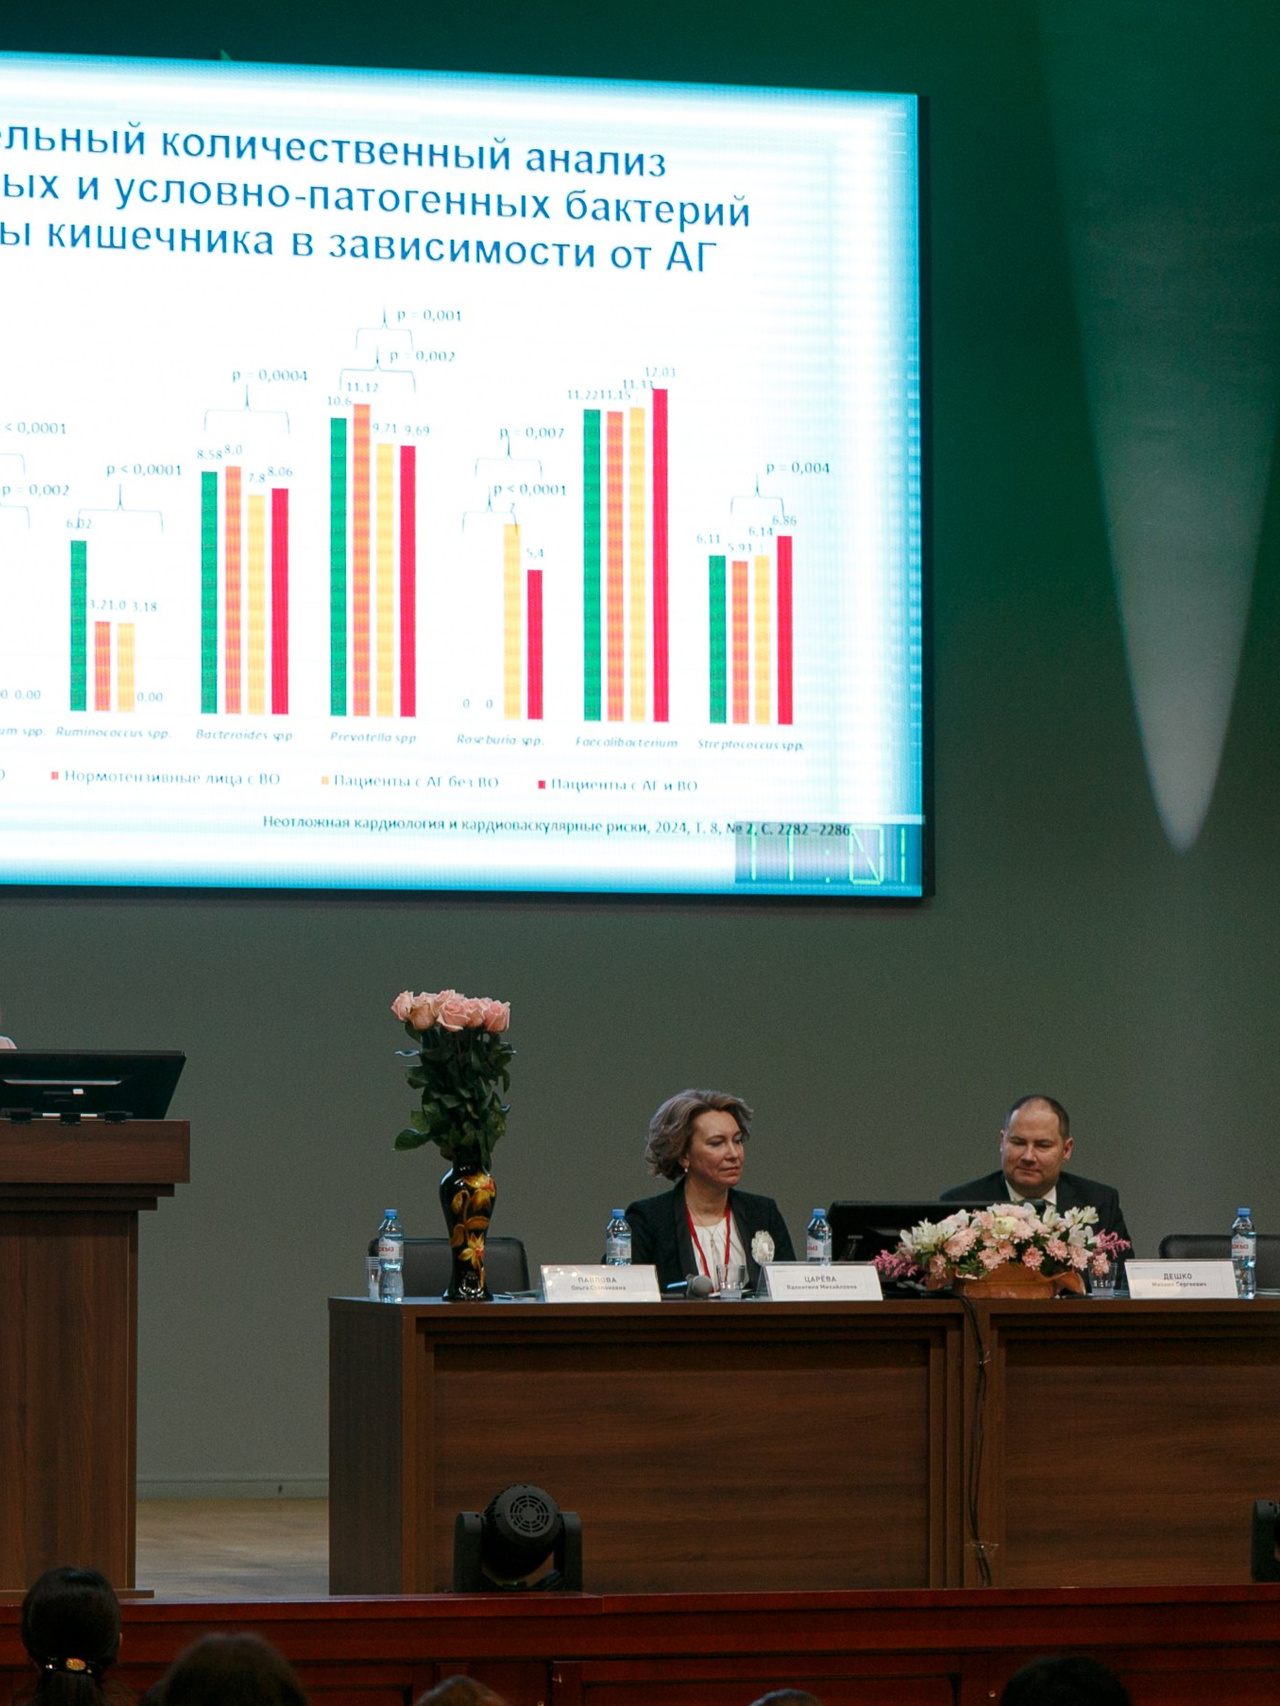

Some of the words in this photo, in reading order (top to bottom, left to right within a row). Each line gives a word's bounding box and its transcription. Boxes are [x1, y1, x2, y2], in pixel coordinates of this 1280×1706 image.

[161, 129, 510, 171] количественный
[526, 146, 666, 178] анализ
[78, 176, 99, 201] и
[115, 176, 550, 220] условно-патогенных
[566, 189, 750, 233] бактерий
[48, 221, 273, 256] кишечника
[292, 231, 314, 257] в
[329, 234, 596, 268] зависимости
[610, 245, 652, 270] от
[665, 240, 718, 273] АГ
[397, 309, 406, 322] p
[423, 309, 462, 322] 0,001
[390, 351, 398, 363] p
[416, 350, 455, 363] 0,002
[232, 370, 241, 383] p
[259, 369, 308, 382] 0,0004
[17, 421, 67, 436] 0,0001
[499, 426, 508, 439] p
[525, 426, 564, 440] 0,007
[107, 463, 115, 476] p
[133, 463, 182, 477] 0,0001
[766, 462, 775, 475] p
[791, 461, 830, 475] 0,004
[2, 484, 11, 498] p
[29, 483, 69, 497] 0,002
[493, 484, 502, 497] p
[519, 484, 567, 496] 0,0001
[55, 726, 144, 738] Ruminococcus
[195, 729, 269, 741] Bacteroides
[329, 731, 392, 743] Prevotella
[456, 734, 517, 745] Roseburia
[575, 736, 678, 749] Faecalibacterium
[697, 738, 779, 751] Streptococcus
[64, 770, 201, 784] Нормотензивные
[205, 773, 243, 786] лица
[259, 773, 281, 785] ВО
[334, 774, 411, 789] Пациенты
[426, 775, 444, 787] АГ
[448, 774, 473, 788] без
[478, 776, 499, 788] ВО
[551, 778, 627, 793] Пациенты
[641, 779, 659, 791] АГ
[663, 781, 673, 791] и
[677, 780, 698, 792] ВО
[263, 815, 349, 828] Неотложная
[354, 819, 445, 833] кардиология
[449, 820, 458, 830] и
[461, 819, 603, 835] кардиоваскулярные
[606, 822, 651, 836] риски,
[655, 821, 690, 835] 2024,
[804, 1275, 837, 1283] ЦАРЁВА
[1163, 1272, 1193, 1281] ДЕШКО
